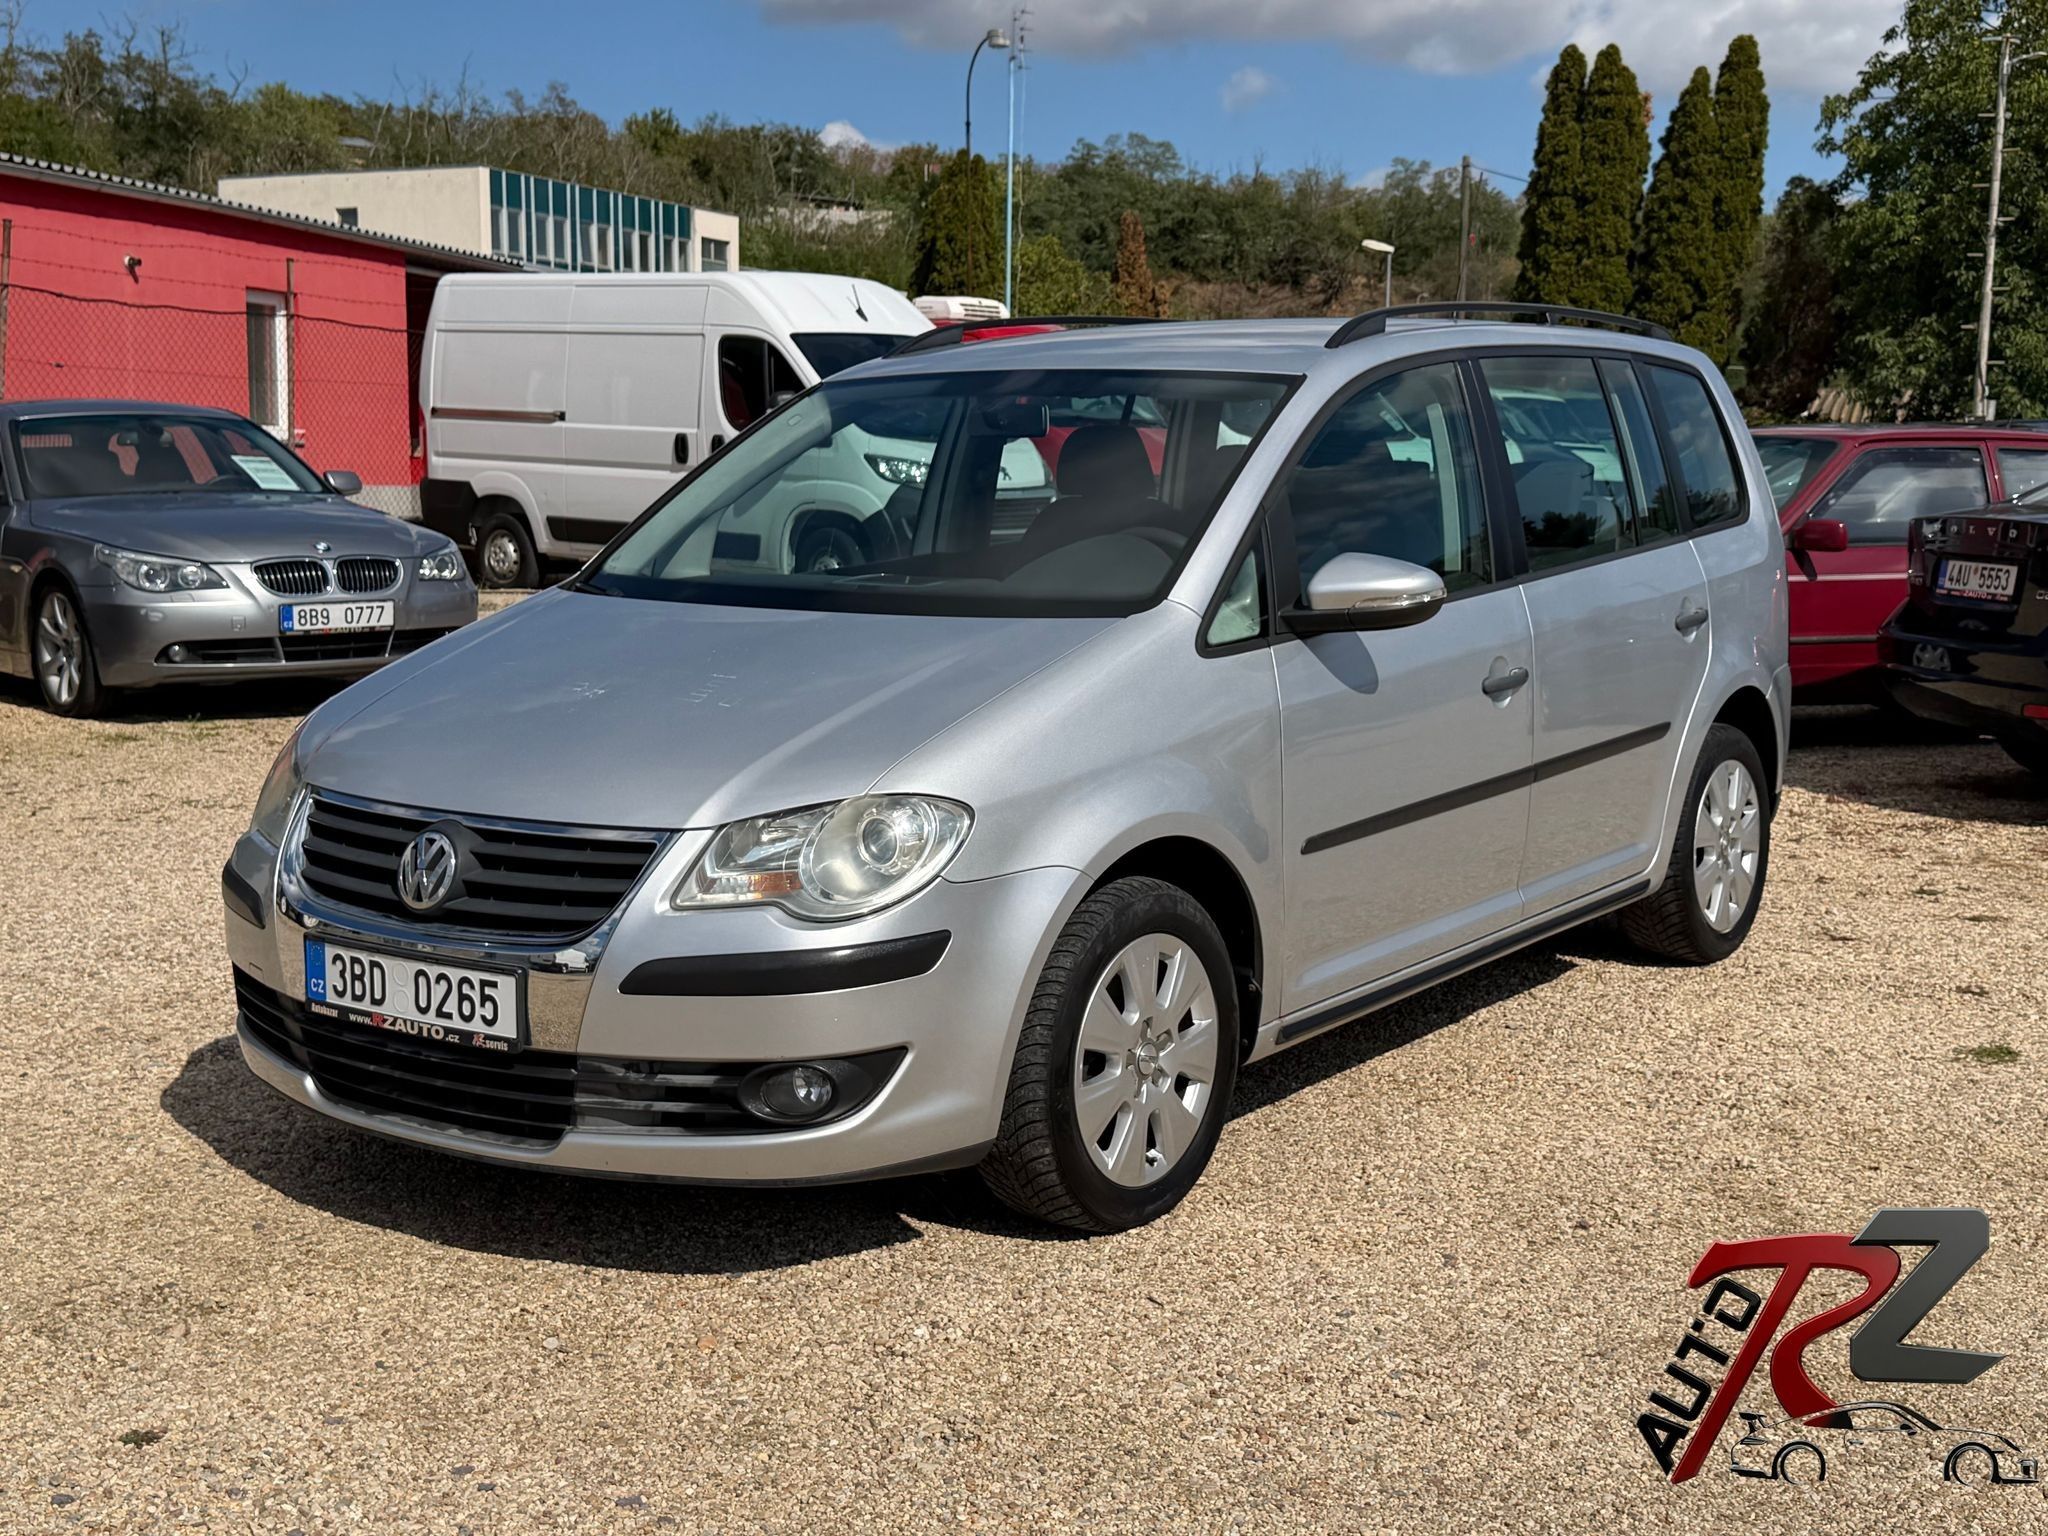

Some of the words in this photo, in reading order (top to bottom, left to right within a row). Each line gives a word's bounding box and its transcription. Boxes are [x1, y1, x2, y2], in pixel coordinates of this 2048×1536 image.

[1936, 523, 2018, 538] OLVO
[1948, 563, 1972, 587] 4AU
[1978, 566, 2011, 591] 5553
[297, 607, 330, 627] 8B9
[344, 605, 385, 625] 0777
[311, 977, 325, 994] CZ
[331, 952, 387, 1007] 3BD
[414, 968, 499, 1027] 0265
[311, 1001, 339, 1018] Autobazar
